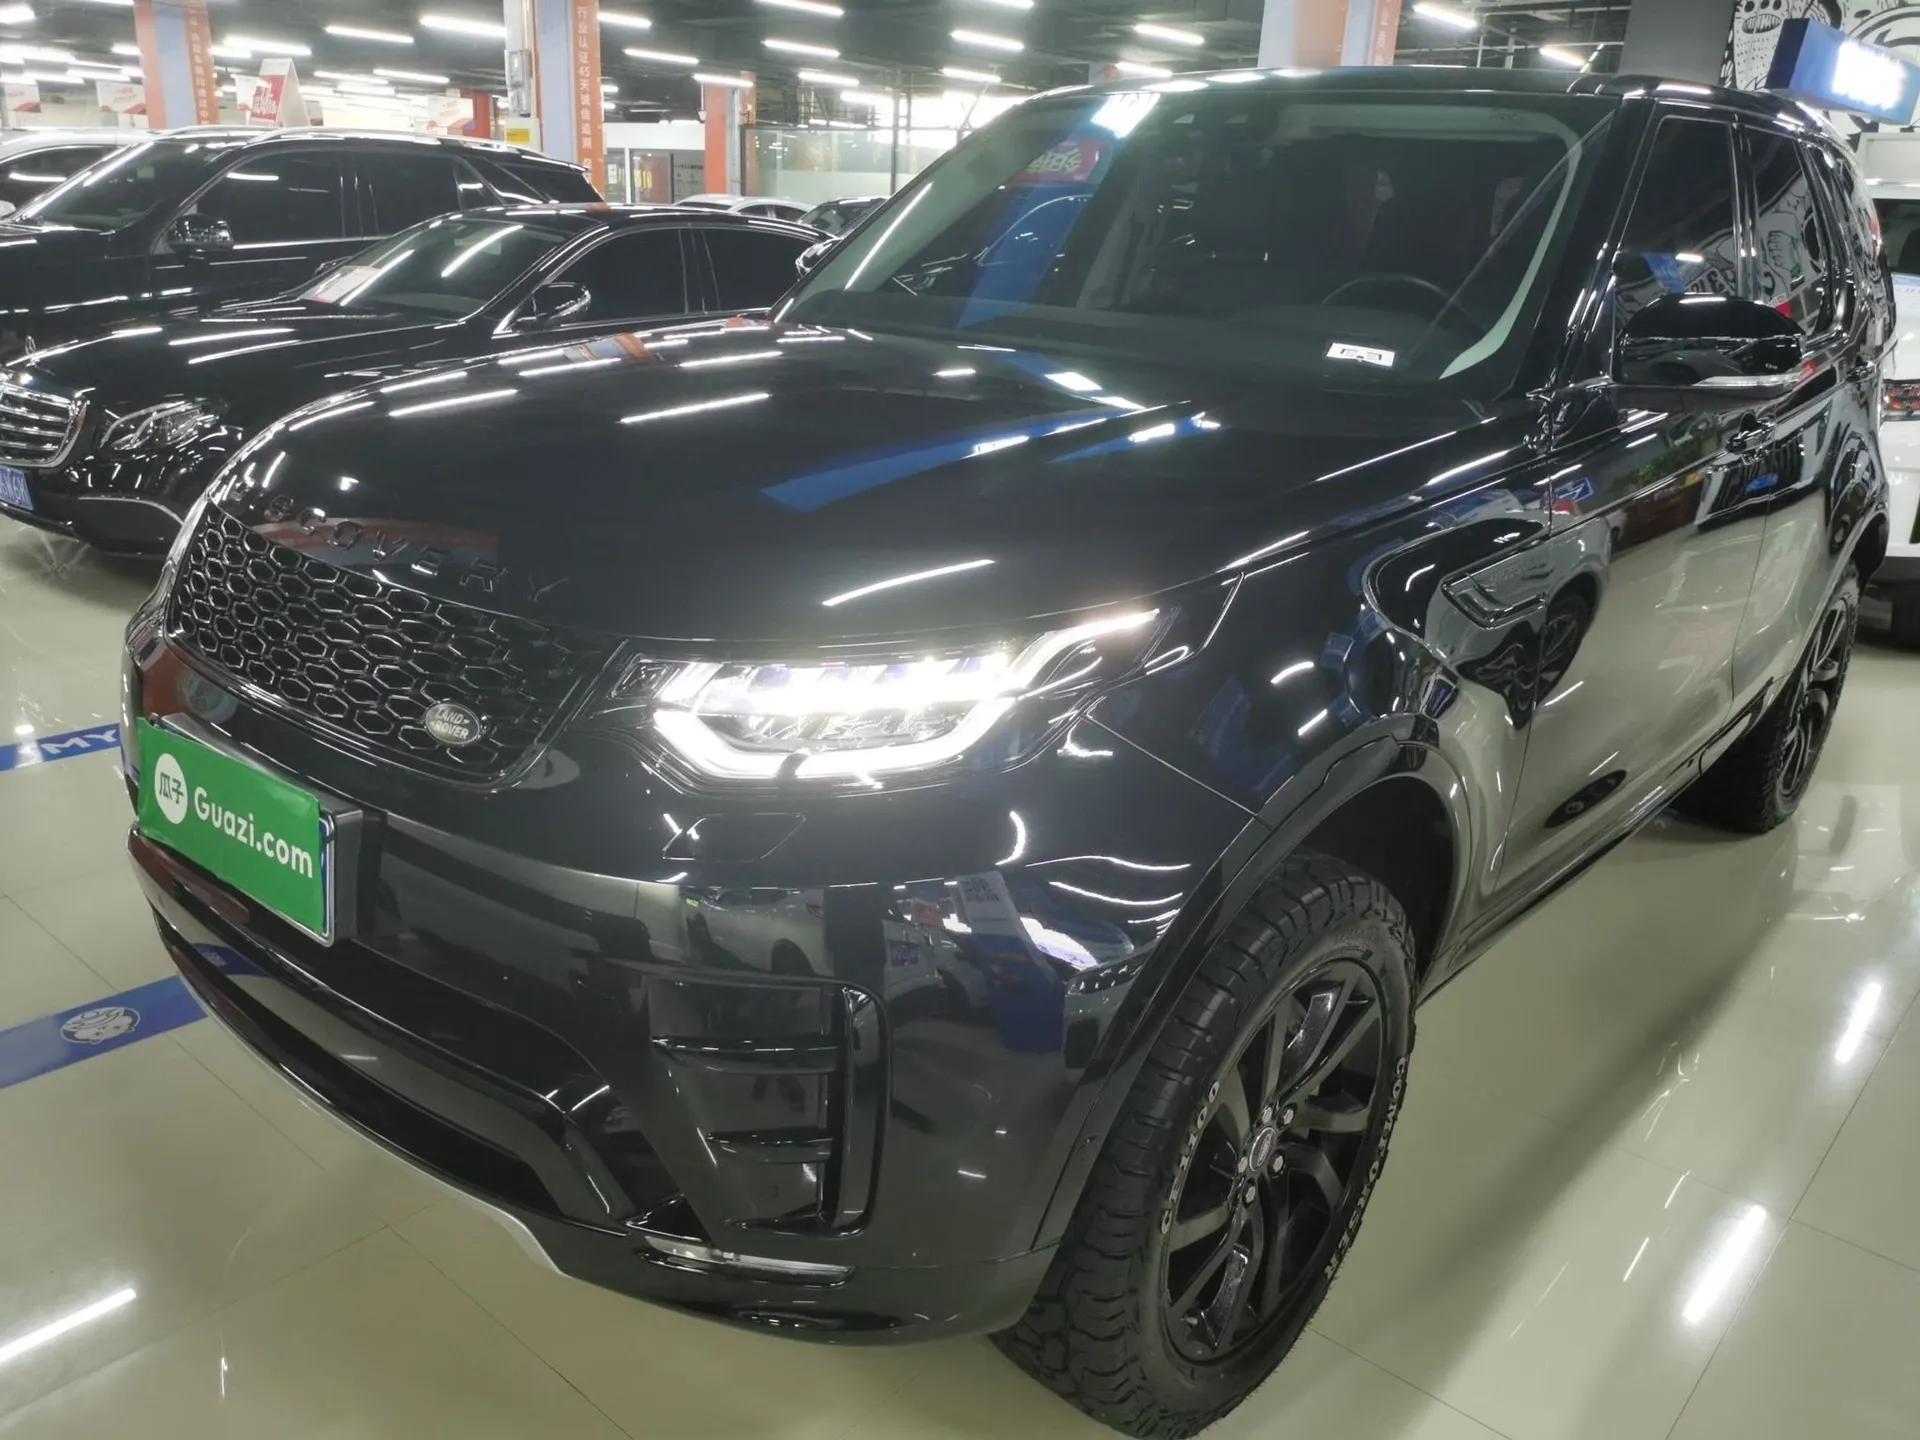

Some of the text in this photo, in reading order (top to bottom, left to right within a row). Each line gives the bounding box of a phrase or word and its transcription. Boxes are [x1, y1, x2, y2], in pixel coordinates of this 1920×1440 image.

[159, 772, 185, 805] 瓜子
[194, 786, 313, 879] Guazi.com
[1324, 1056, 1407, 1280] COMFORSER
